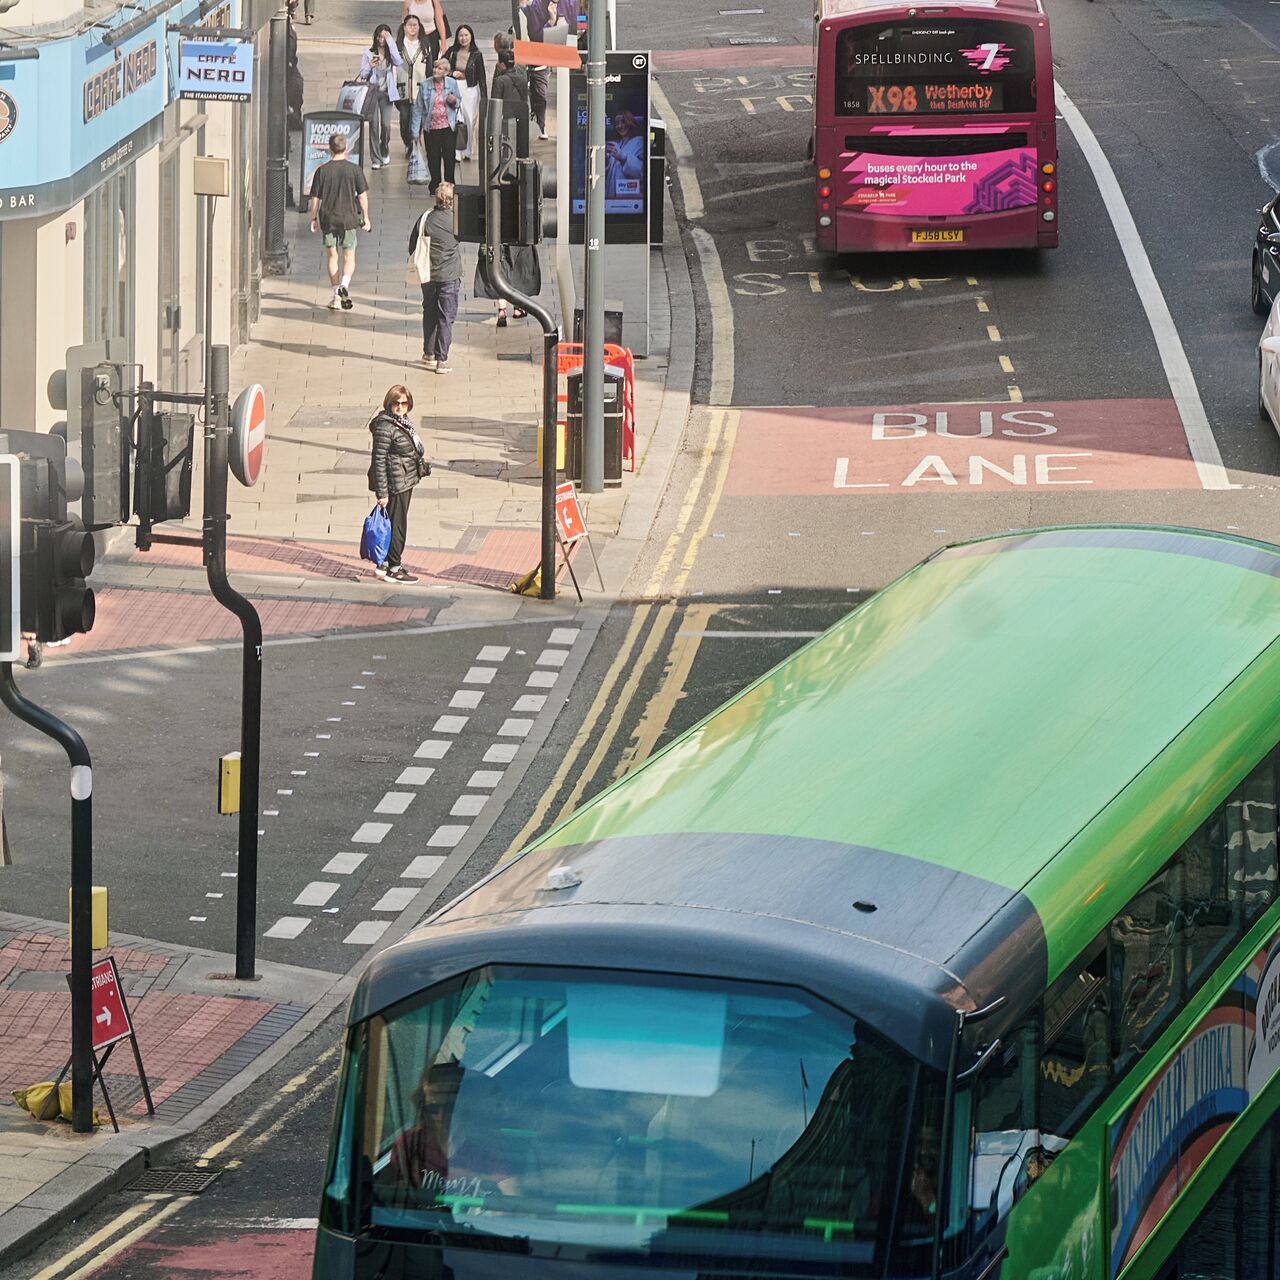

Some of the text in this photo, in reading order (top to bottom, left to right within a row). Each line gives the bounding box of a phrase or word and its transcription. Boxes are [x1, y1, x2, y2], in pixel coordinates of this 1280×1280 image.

[855, 52, 953, 66] SPELLBINDING
[980, 43, 999, 70] 7
[123, 39, 157, 99] NERO
[187, 68, 246, 83] NERO
[868, 85, 918, 113] X98
[925, 84, 993, 100] Wetherby
[843, 100, 861, 109] 1858
[310, 123, 351, 136] VOODOO
[867, 161, 978, 175] buses every hour to the
[864, 173, 967, 186] magical Stockeld Park
[10, 193, 36, 208] BAR
[589, 239, 600, 247] 19
[916, 231, 961, 240] FJ58 LSY
[872, 410, 1058, 440] BUS
[833, 452, 1094, 489] LANE
